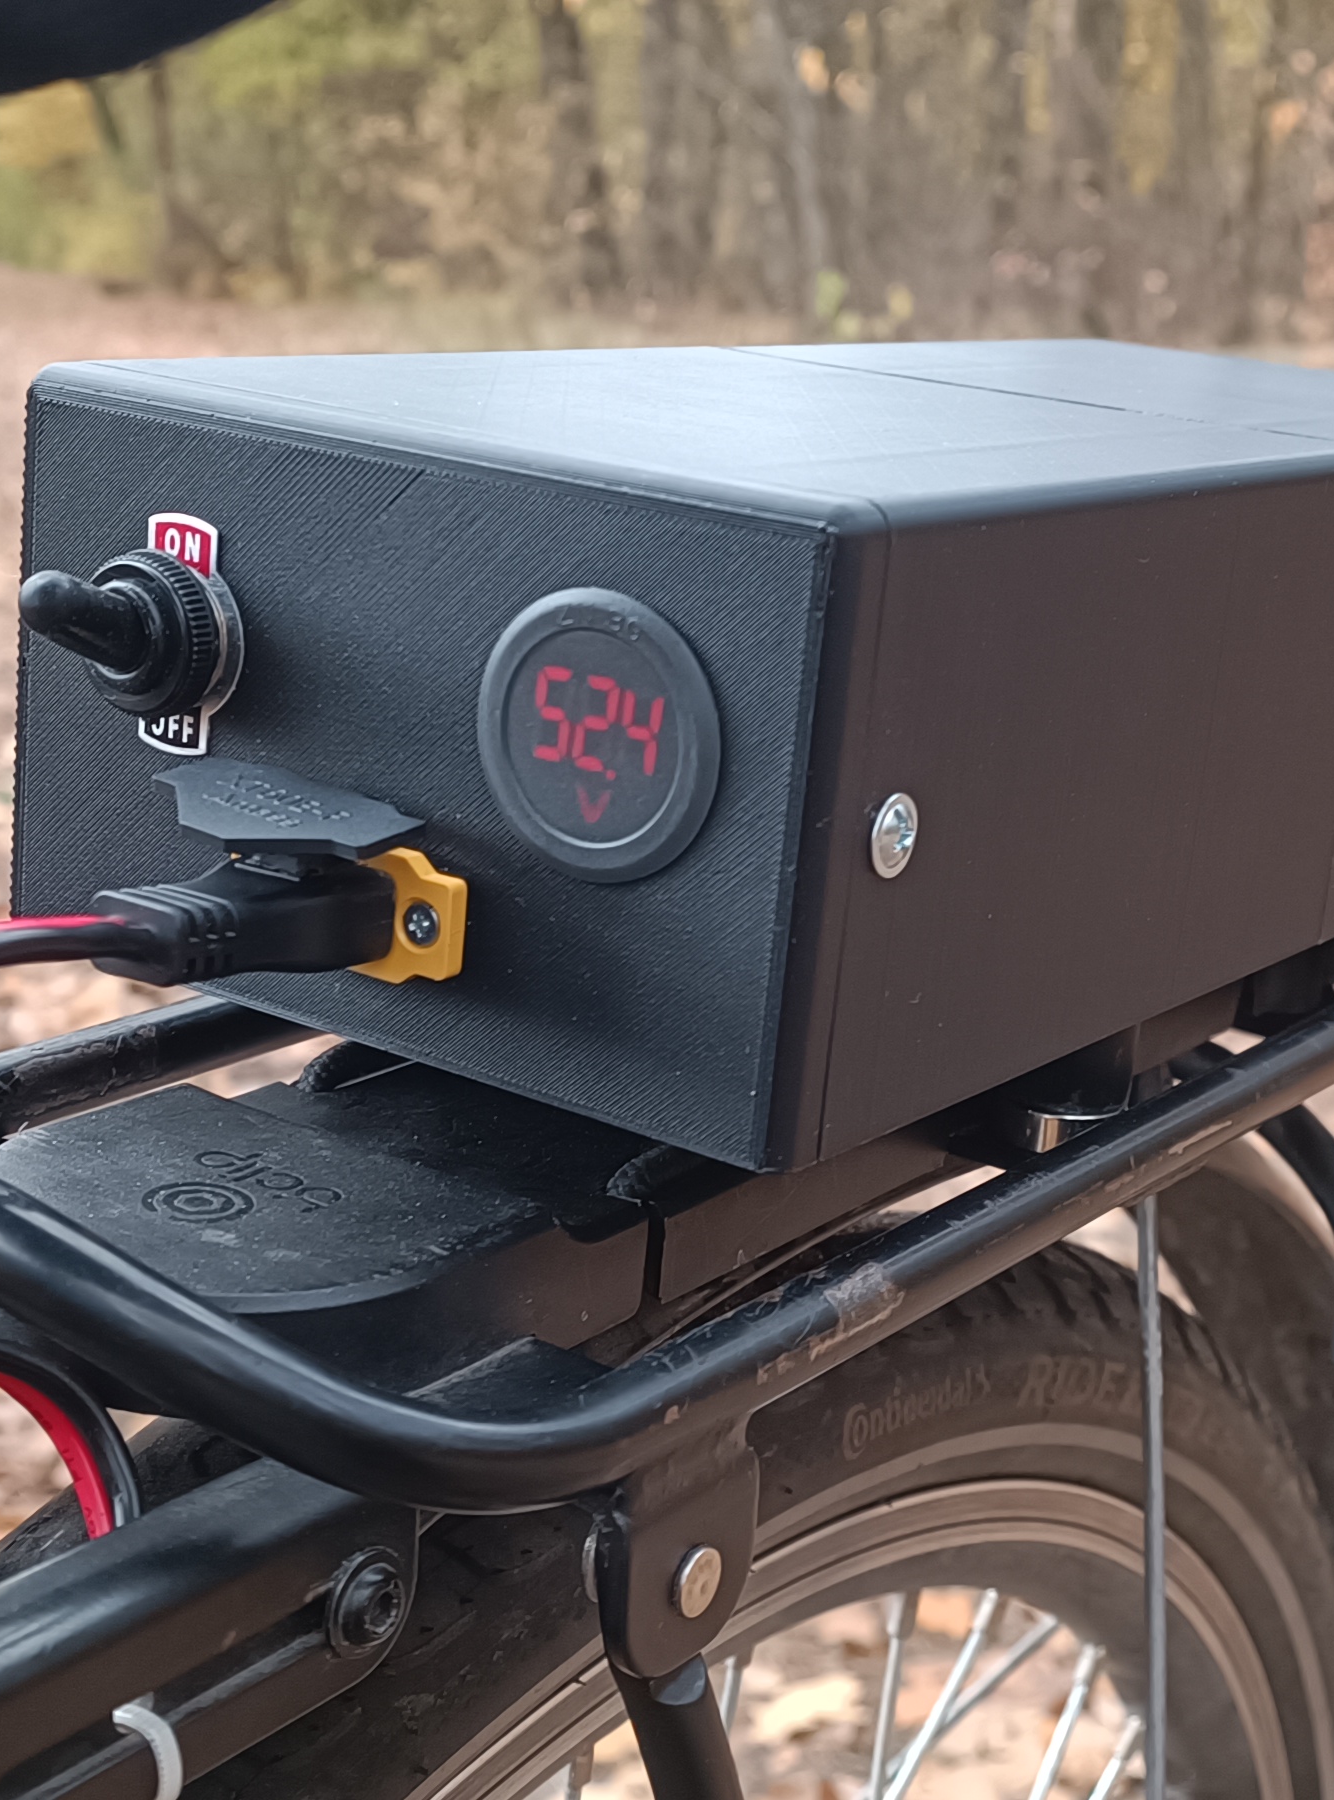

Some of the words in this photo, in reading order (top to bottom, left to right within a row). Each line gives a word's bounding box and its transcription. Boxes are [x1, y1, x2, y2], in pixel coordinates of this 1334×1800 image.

[164, 528, 201, 562] ON
[534, 665, 664, 780] 52.4
[576, 782, 611, 824] V
